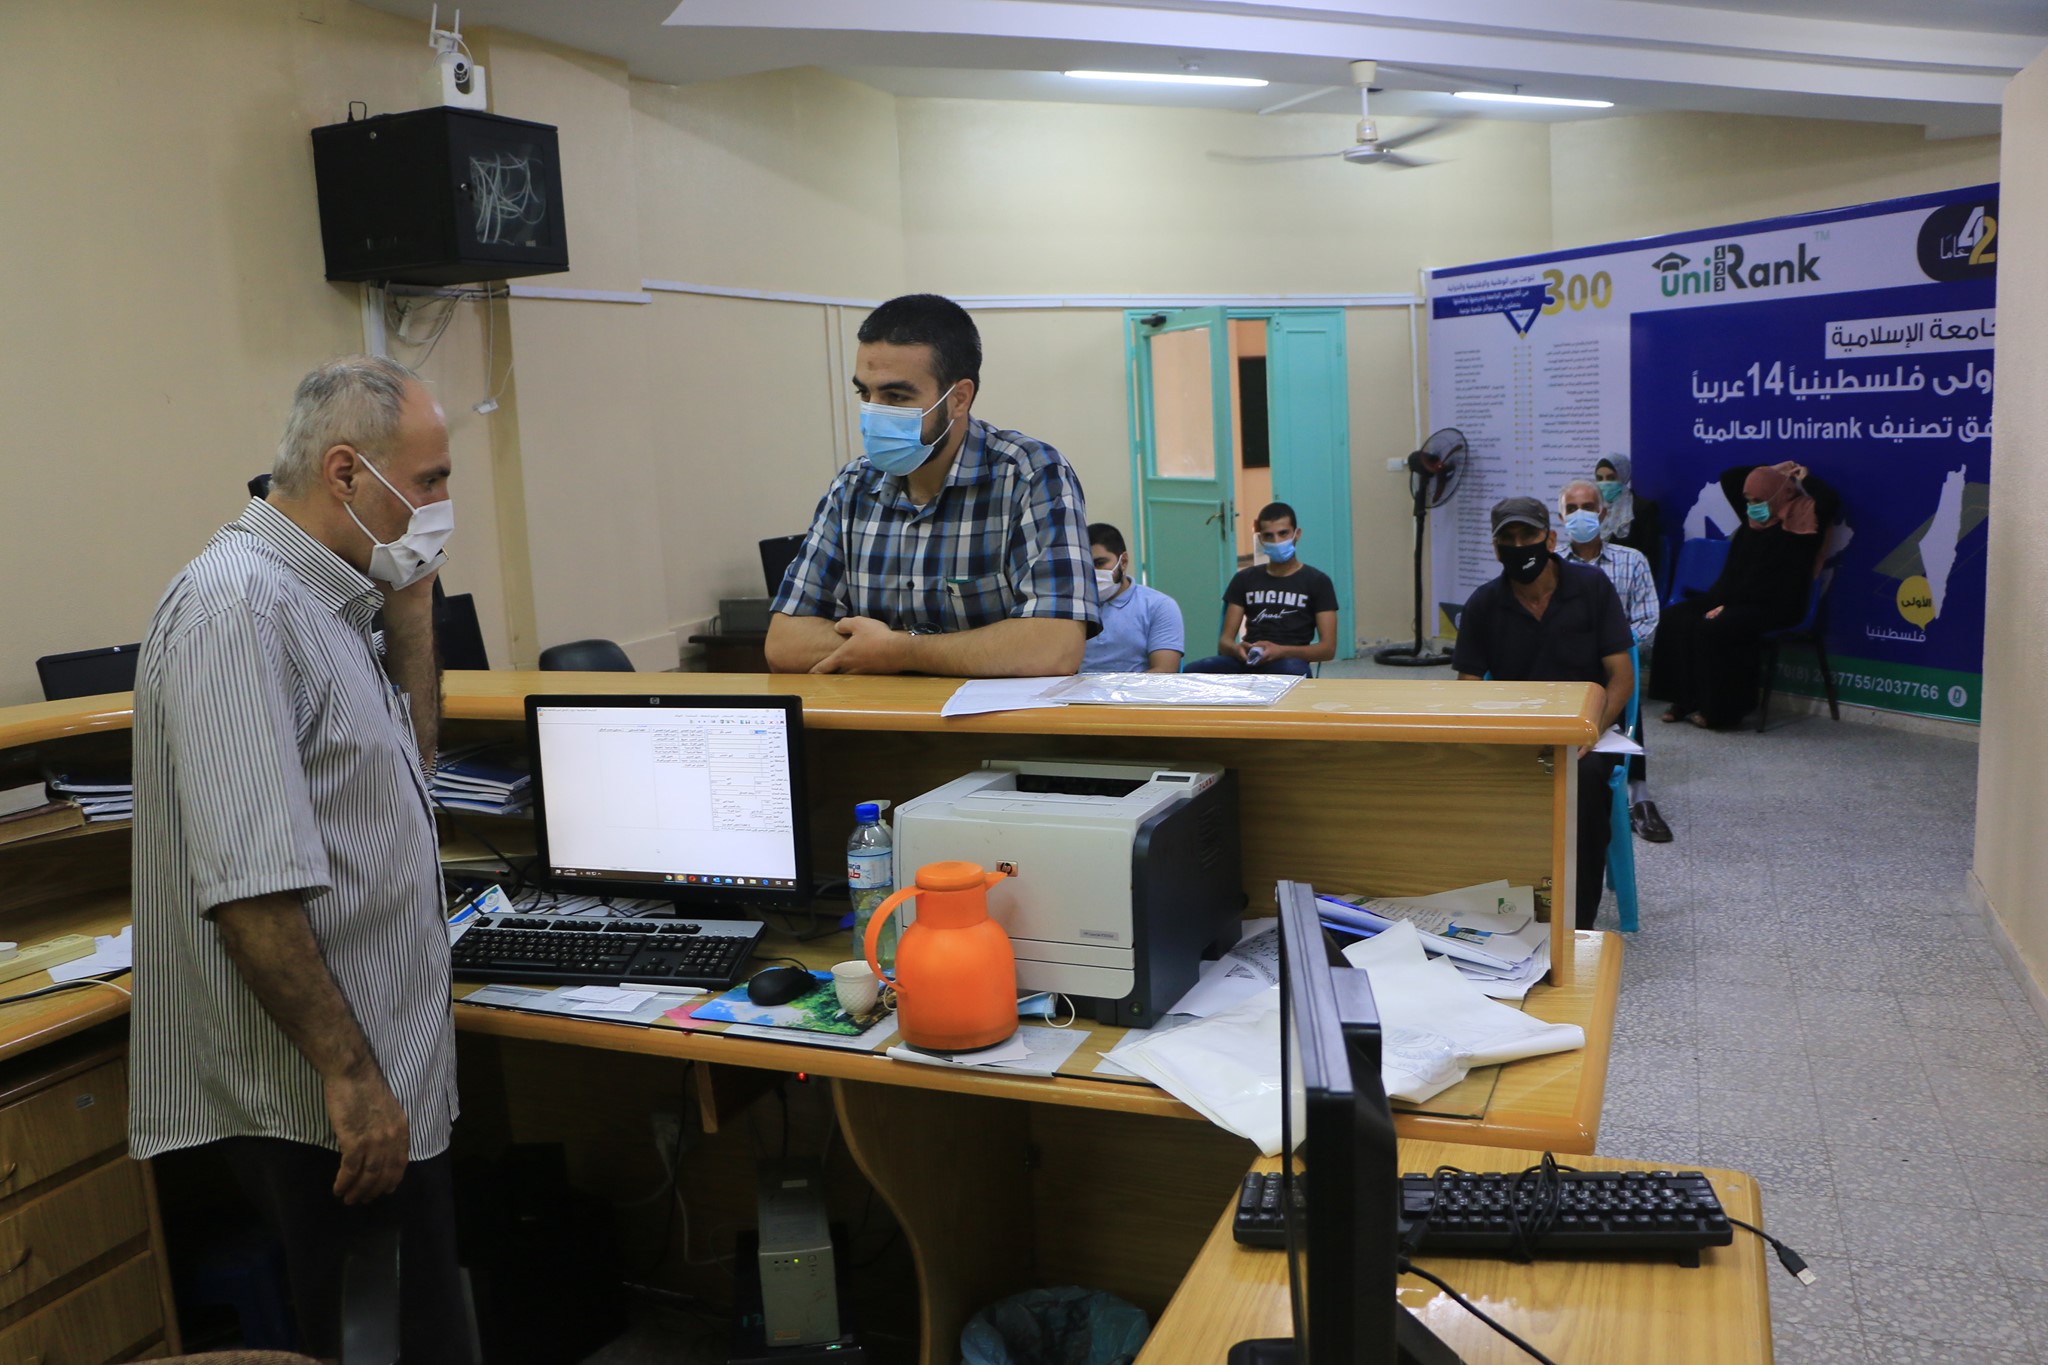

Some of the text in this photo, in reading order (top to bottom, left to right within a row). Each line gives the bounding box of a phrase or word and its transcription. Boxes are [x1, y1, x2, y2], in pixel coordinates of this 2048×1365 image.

[1814, 230, 1831, 241] TM
[1958, 206, 1997, 265] 42
[1541, 269, 1613, 316] 300
[1831, 322, 1924, 352] الإسلامية
[1746, 361, 1785, 396] 14
[1692, 418, 1771, 443] العالمية
[1777, 416, 1863, 439] Unirank
[1868, 415, 1953, 443] تصنيف
[1246, 590, 1308, 608] ENGINE
[1901, 597, 1932, 608] الأولى
[1813, 668, 1940, 700] 237755/2037766
